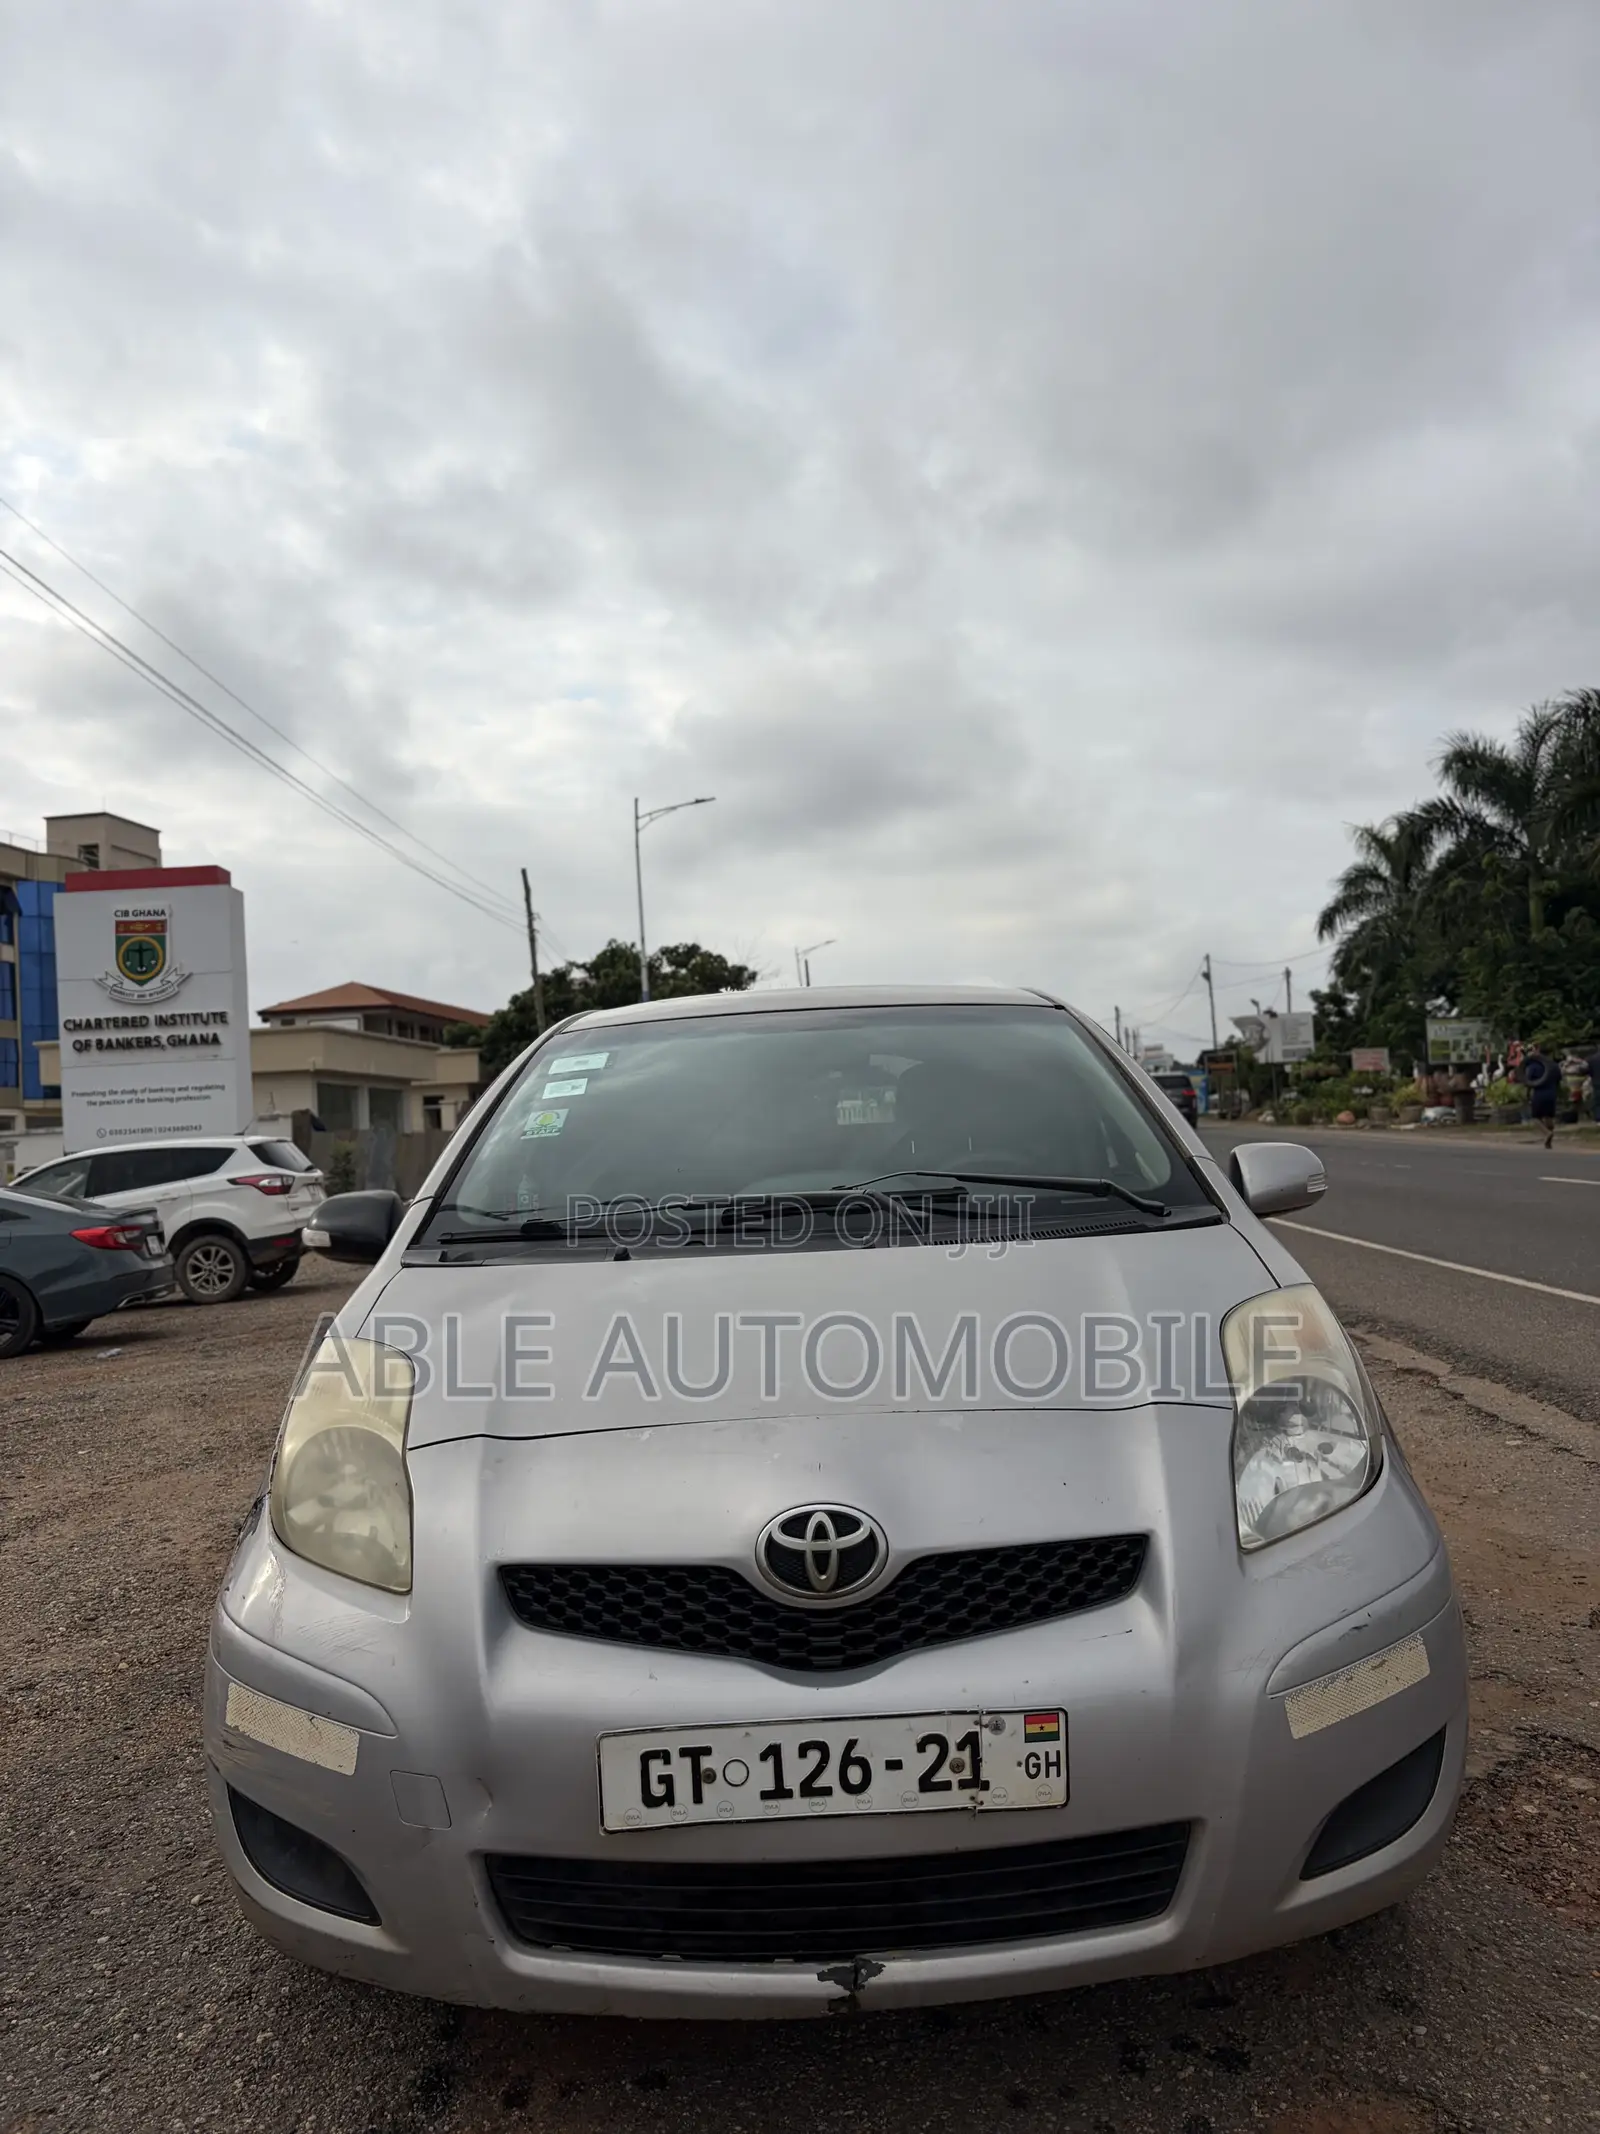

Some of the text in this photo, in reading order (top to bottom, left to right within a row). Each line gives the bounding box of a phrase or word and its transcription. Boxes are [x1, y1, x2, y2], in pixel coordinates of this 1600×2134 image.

[114, 909, 166, 918] CIB GHANA
[63, 1011, 229, 1032] CHARTERED INSTITUTE
[72, 1038, 92, 1052] OF
[166, 1032, 222, 1048] GHANA
[108, 1088, 119, 1096] the
[120, 1086, 138, 1096] study
[140, 1086, 147, 1094] of
[148, 1085, 176, 1094] banking
[177, 1084, 189, 1092] and
[191, 1083, 226, 1092] regulating
[99, 1098, 126, 1107] practice
[127, 1097, 135, 1105] of
[135, 1096, 146, 1105] the
[147, 1095, 175, 1104] banking
[1024, 1749, 1061, 1780] GH
[640, 1746, 712, 1808] GT
